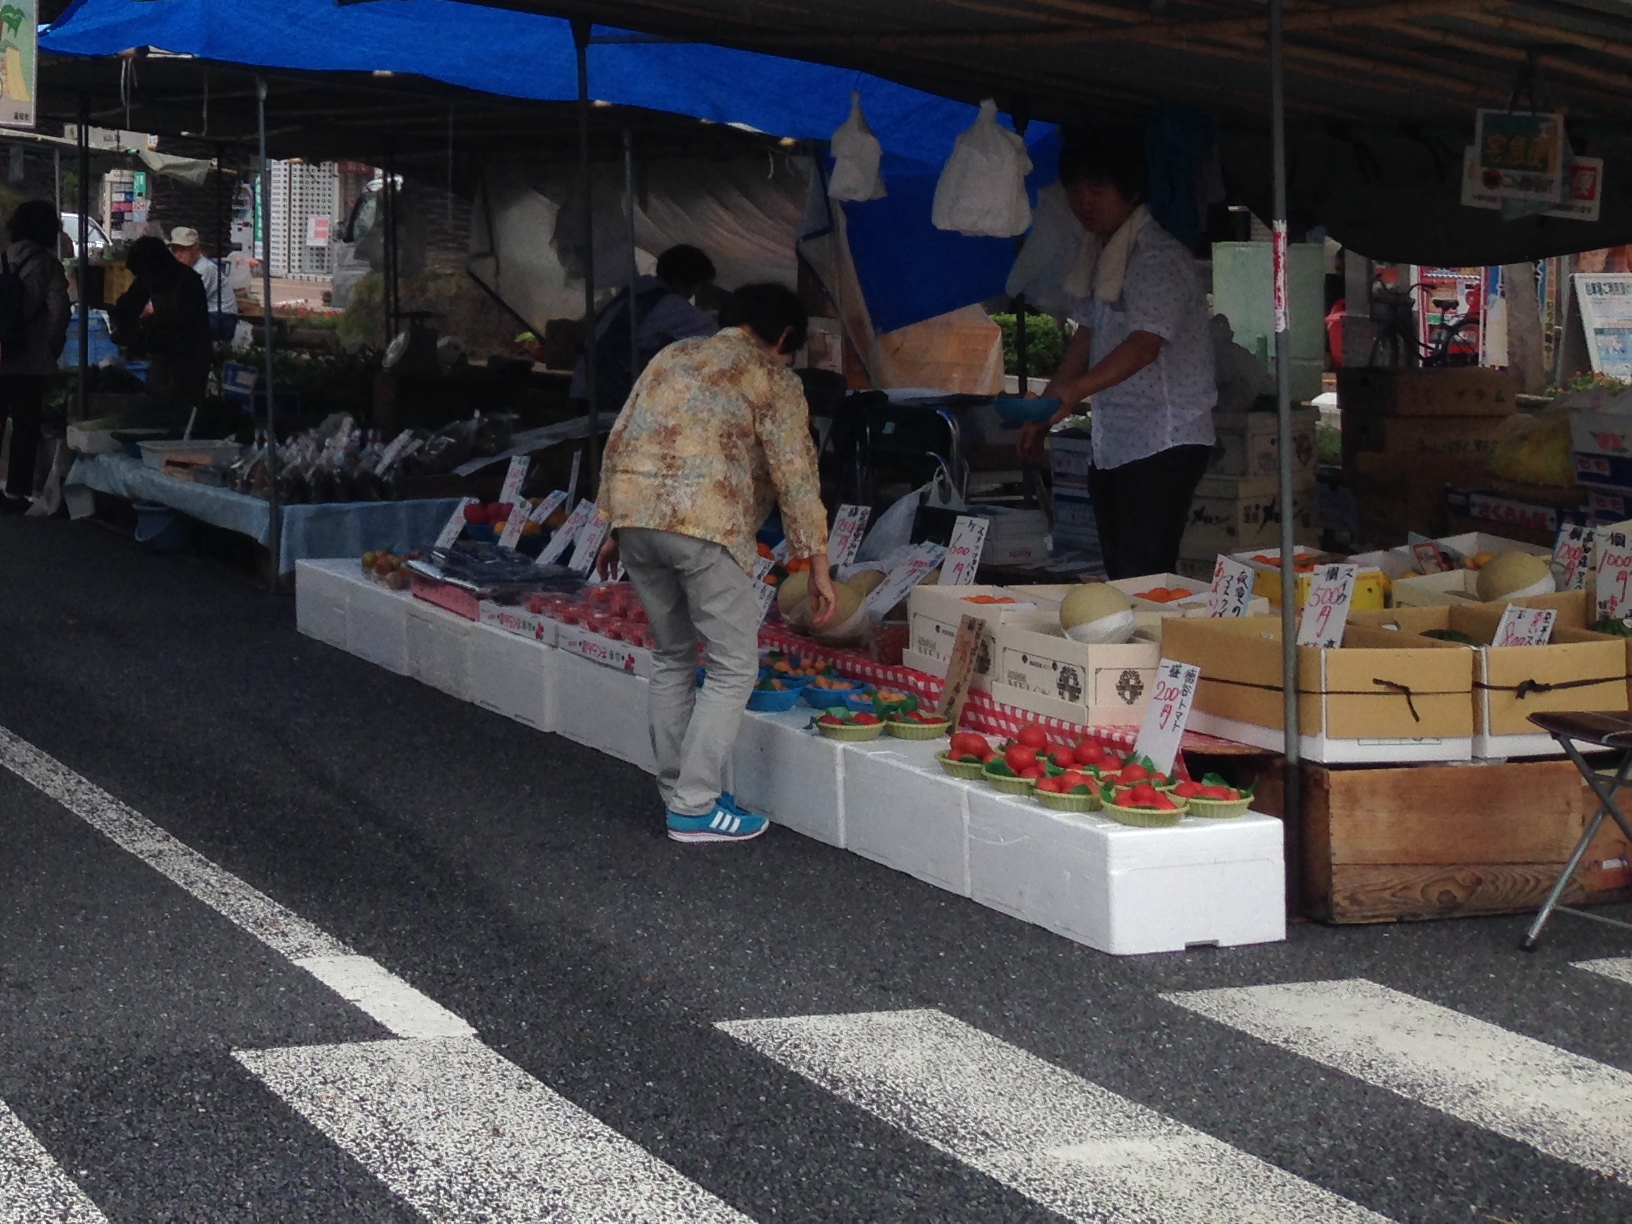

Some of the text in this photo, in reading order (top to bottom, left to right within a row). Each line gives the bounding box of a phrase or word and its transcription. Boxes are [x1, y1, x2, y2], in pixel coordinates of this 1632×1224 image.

[1598, 549, 1632, 574] 1000
[1308, 587, 1340, 607] 500
[1153, 680, 1180, 702] 200
